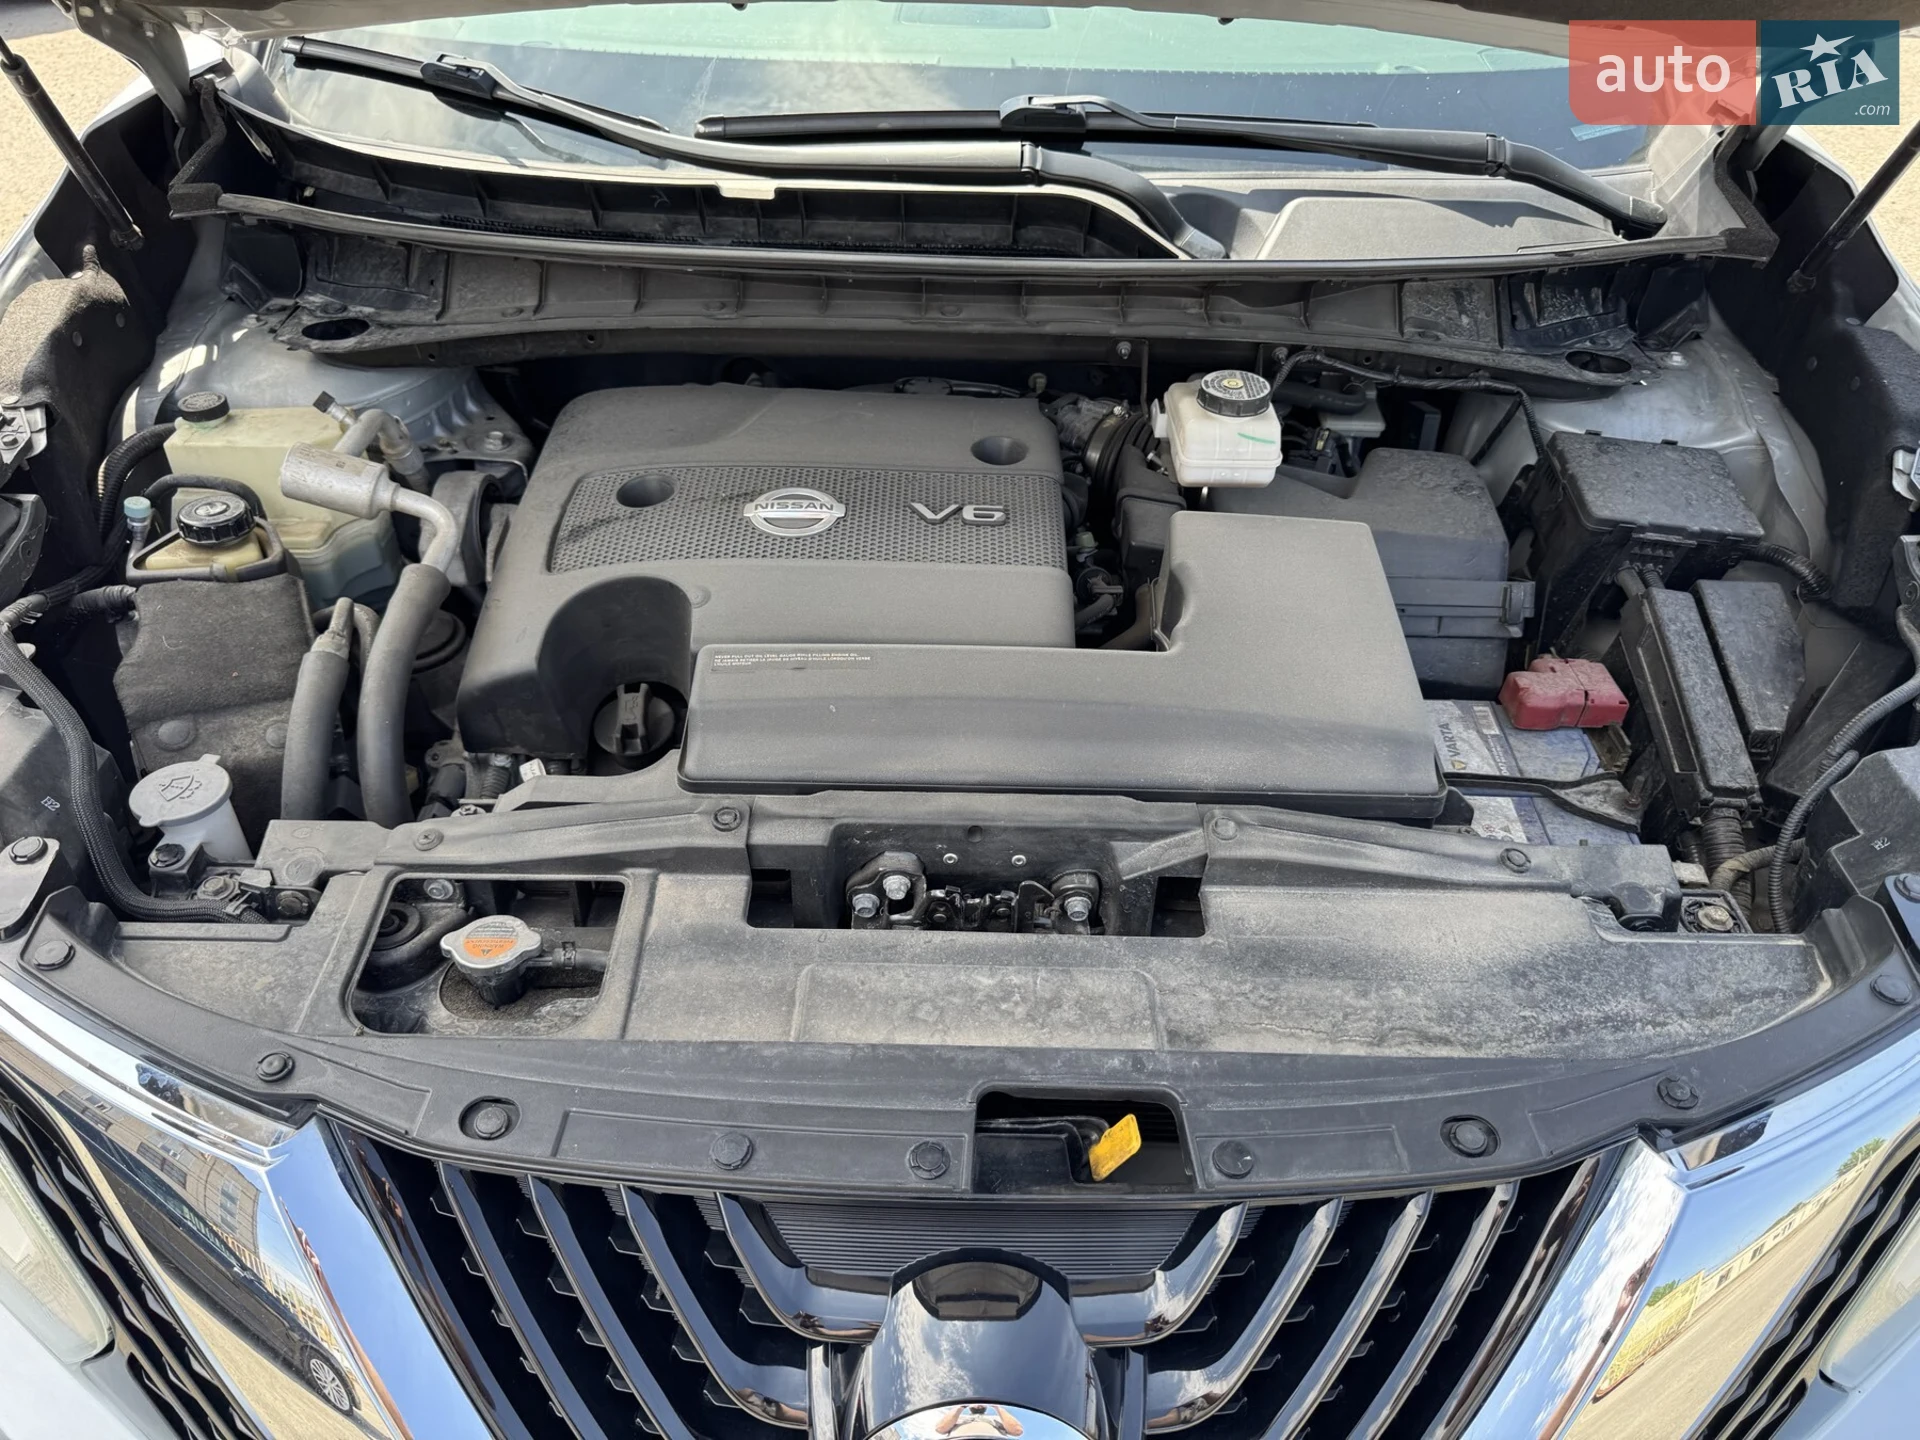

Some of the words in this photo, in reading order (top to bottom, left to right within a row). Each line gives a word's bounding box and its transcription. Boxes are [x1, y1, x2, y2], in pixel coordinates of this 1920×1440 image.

[753, 501, 834, 511] NISSAN
[907, 502, 1007, 526] V6
[1438, 722, 1461, 758] VARTA
